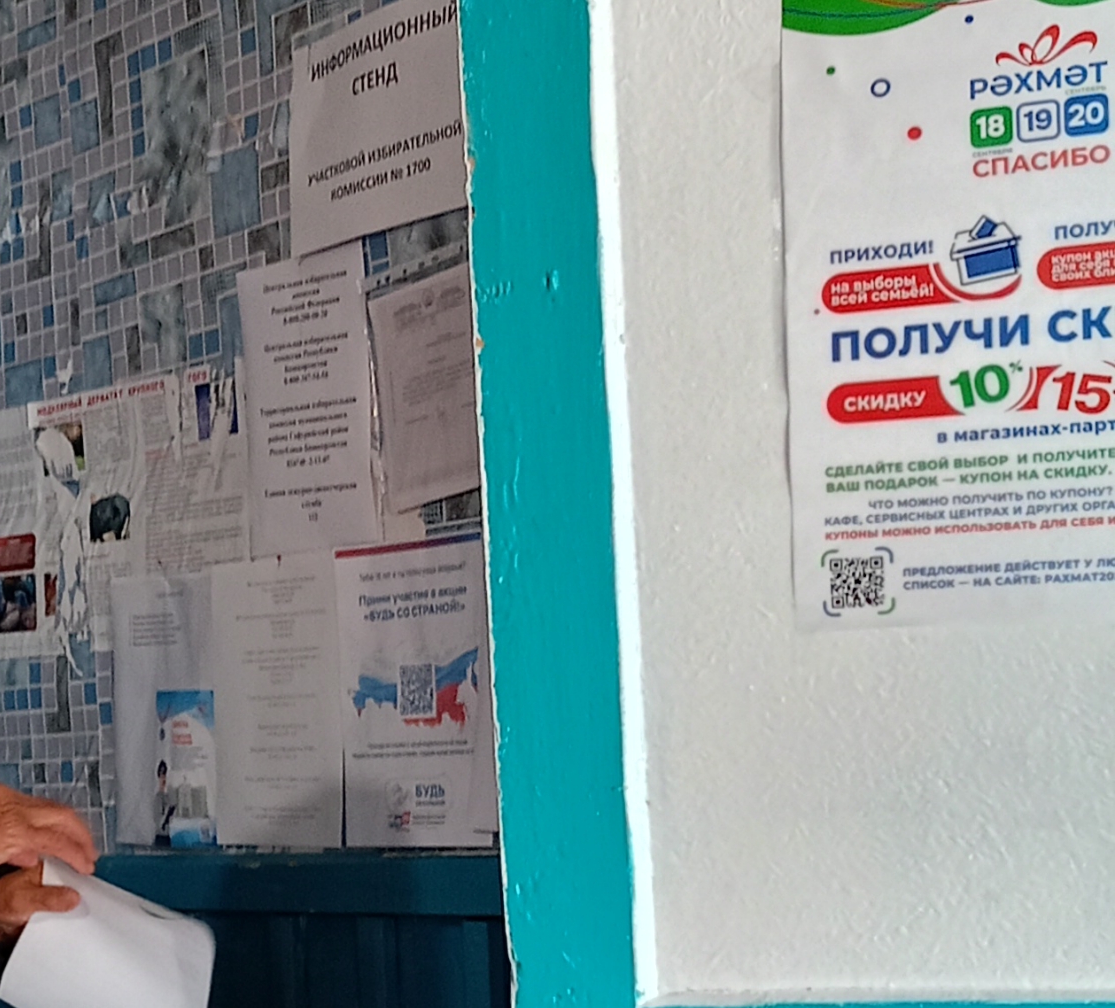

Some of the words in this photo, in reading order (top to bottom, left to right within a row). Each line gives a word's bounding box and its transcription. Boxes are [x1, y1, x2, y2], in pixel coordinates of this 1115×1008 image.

[311, 0, 457, 82] ИНФОРМАЦИОННЫЙ
[351, 62, 399, 95] СТЕНД
[970, 60, 1108, 100] РӘХМӘТ
[975, 114, 1006, 140] 18
[1023, 108, 1052, 132] 19
[1067, 101, 1105, 128] 20
[307, 151, 366, 187] УЧАСТКОВОЙ
[368, 119, 463, 164] ИЗБИРАТЕЛЬНОЙ
[972, 145, 1111, 178] СПАСИБО
[330, 172, 389, 201] КОМИССИИ
[405, 158, 431, 178] 1700
[830, 240, 934, 264] ПРИХОДИ!
[831, 313, 1029, 363] ПОЛУЧИ
[1047, 305, 1113, 343] СК
[844, 390, 927, 413] СКИДКУ
[1052, 371, 1115, 414] 15
[937, 432, 948, 444] в
[825, 460, 903, 478] СДЕЛАЙТЕ
[907, 456, 949, 472] СВОЙ
[953, 455, 1009, 469] ВЫБОР
[1017, 453, 1028, 465] И
[1032, 447, 1115, 463] ПОЛУЧИТЕ
[826, 480, 860, 493] ВАШ
[864, 475, 938, 491] ПОДАРОК
[959, 471, 1013, 484] КУПОН
[1017, 469, 1039, 481] НА
[1043, 464, 1113, 479] СКИДКУ.
[868, 499, 894, 509] ЧТО
[897, 496, 949, 508] МОЖНО
[952, 492, 1024, 505] ПОЛУЧИТЬ
[1026, 490, 1047, 500] ПО
[1050, 486, 1113, 499] КУПОНУ?
[824, 515, 864, 526] КАФЕ,
[866, 510, 945, 524] СЕРВИСНЫХ
[949, 506, 1010, 520] ЦЕНТРАХ
[1013, 506, 1023, 516] И
[1026, 502, 1079, 516] ДРУГИХ
[825, 529, 878, 540] КУПОНЫ
[882, 526, 931, 537] МОЖНО
[934, 521, 1037, 534] ИСПОЛЬЗОВАТЬ
[1040, 518, 1068, 530] ДЛЯ
[1071, 516, 1104, 527] СЕБЯ
[902, 562, 1001, 577] ПРЕДЛОЖЕНИЕ
[1004, 558, 1080, 574] ДЕЙСТВУЕТ
[1083, 558, 1093, 568] У
[903, 579, 955, 590] СПИСОК
[973, 577, 991, 587] НА
[995, 573, 1041, 586] САЙТЕ:
[1044, 571, 1115, 583] РАХМАТ20
[415, 783, 445, 799] БУДЬ
